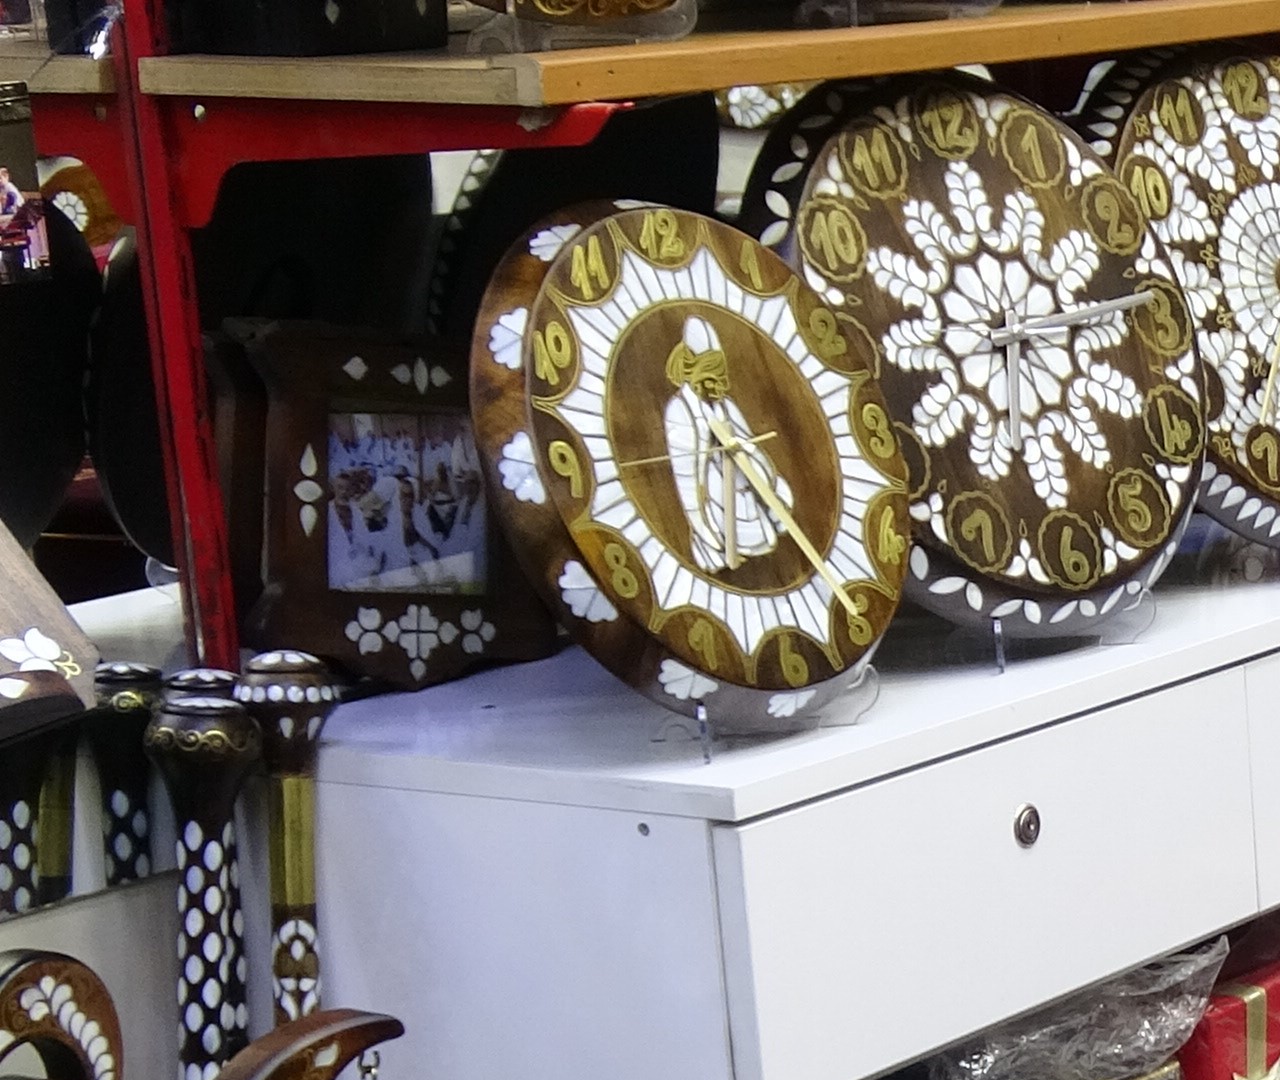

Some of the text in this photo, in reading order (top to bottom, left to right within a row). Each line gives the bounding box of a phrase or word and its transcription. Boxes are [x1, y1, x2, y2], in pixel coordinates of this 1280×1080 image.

[1159, 87, 1199, 142] 11
[1222, 62, 1270, 117] 12
[921, 103, 975, 152] 12
[1020, 124, 1048, 181] 1
[852, 128, 898, 190] 11
[1094, 191, 1135, 248] 2
[1130, 164, 1169, 220] 10
[639, 210, 685, 260] 12
[809, 209, 860, 271] 10
[570, 234, 611, 300] 11
[739, 238, 764, 291] 1
[808, 307, 848, 358] 2
[1147, 285, 1181, 351] 3
[533, 320, 572, 386] 10
[861, 402, 896, 459] 3
[1156, 396, 1193, 455] 4
[547, 439, 583, 499] 9
[1250, 433, 1279, 483] 7
[1118, 475, 1152, 532] 5
[878, 505, 906, 566] 4
[960, 509, 996, 563] 7
[1060, 525, 1090, 583] 6
[603, 542, 639, 600] 8
[687, 619, 718, 671] 7
[780, 634, 809, 687] 6
